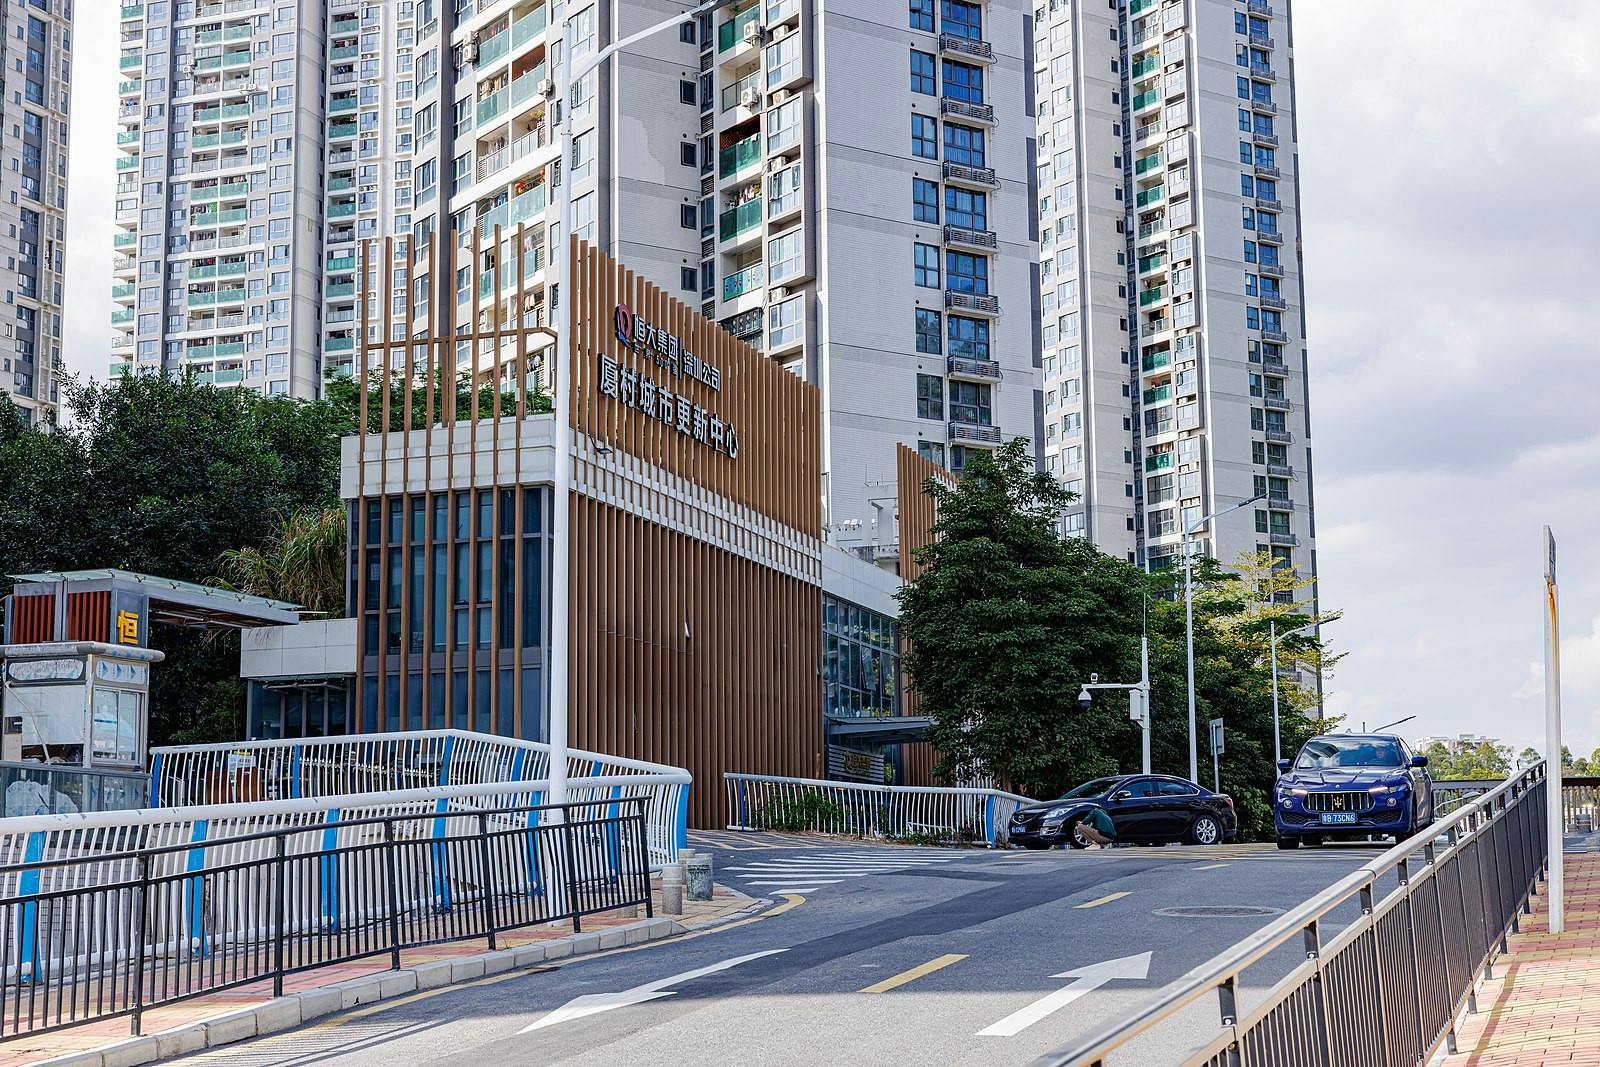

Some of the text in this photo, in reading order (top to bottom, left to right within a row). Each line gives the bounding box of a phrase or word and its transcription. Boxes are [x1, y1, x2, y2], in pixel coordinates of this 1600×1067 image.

[634, 314, 678, 361] 恒大集团
[600, 354, 738, 459] 厦村城市更新中心
[118, 608, 138, 644] 恒
